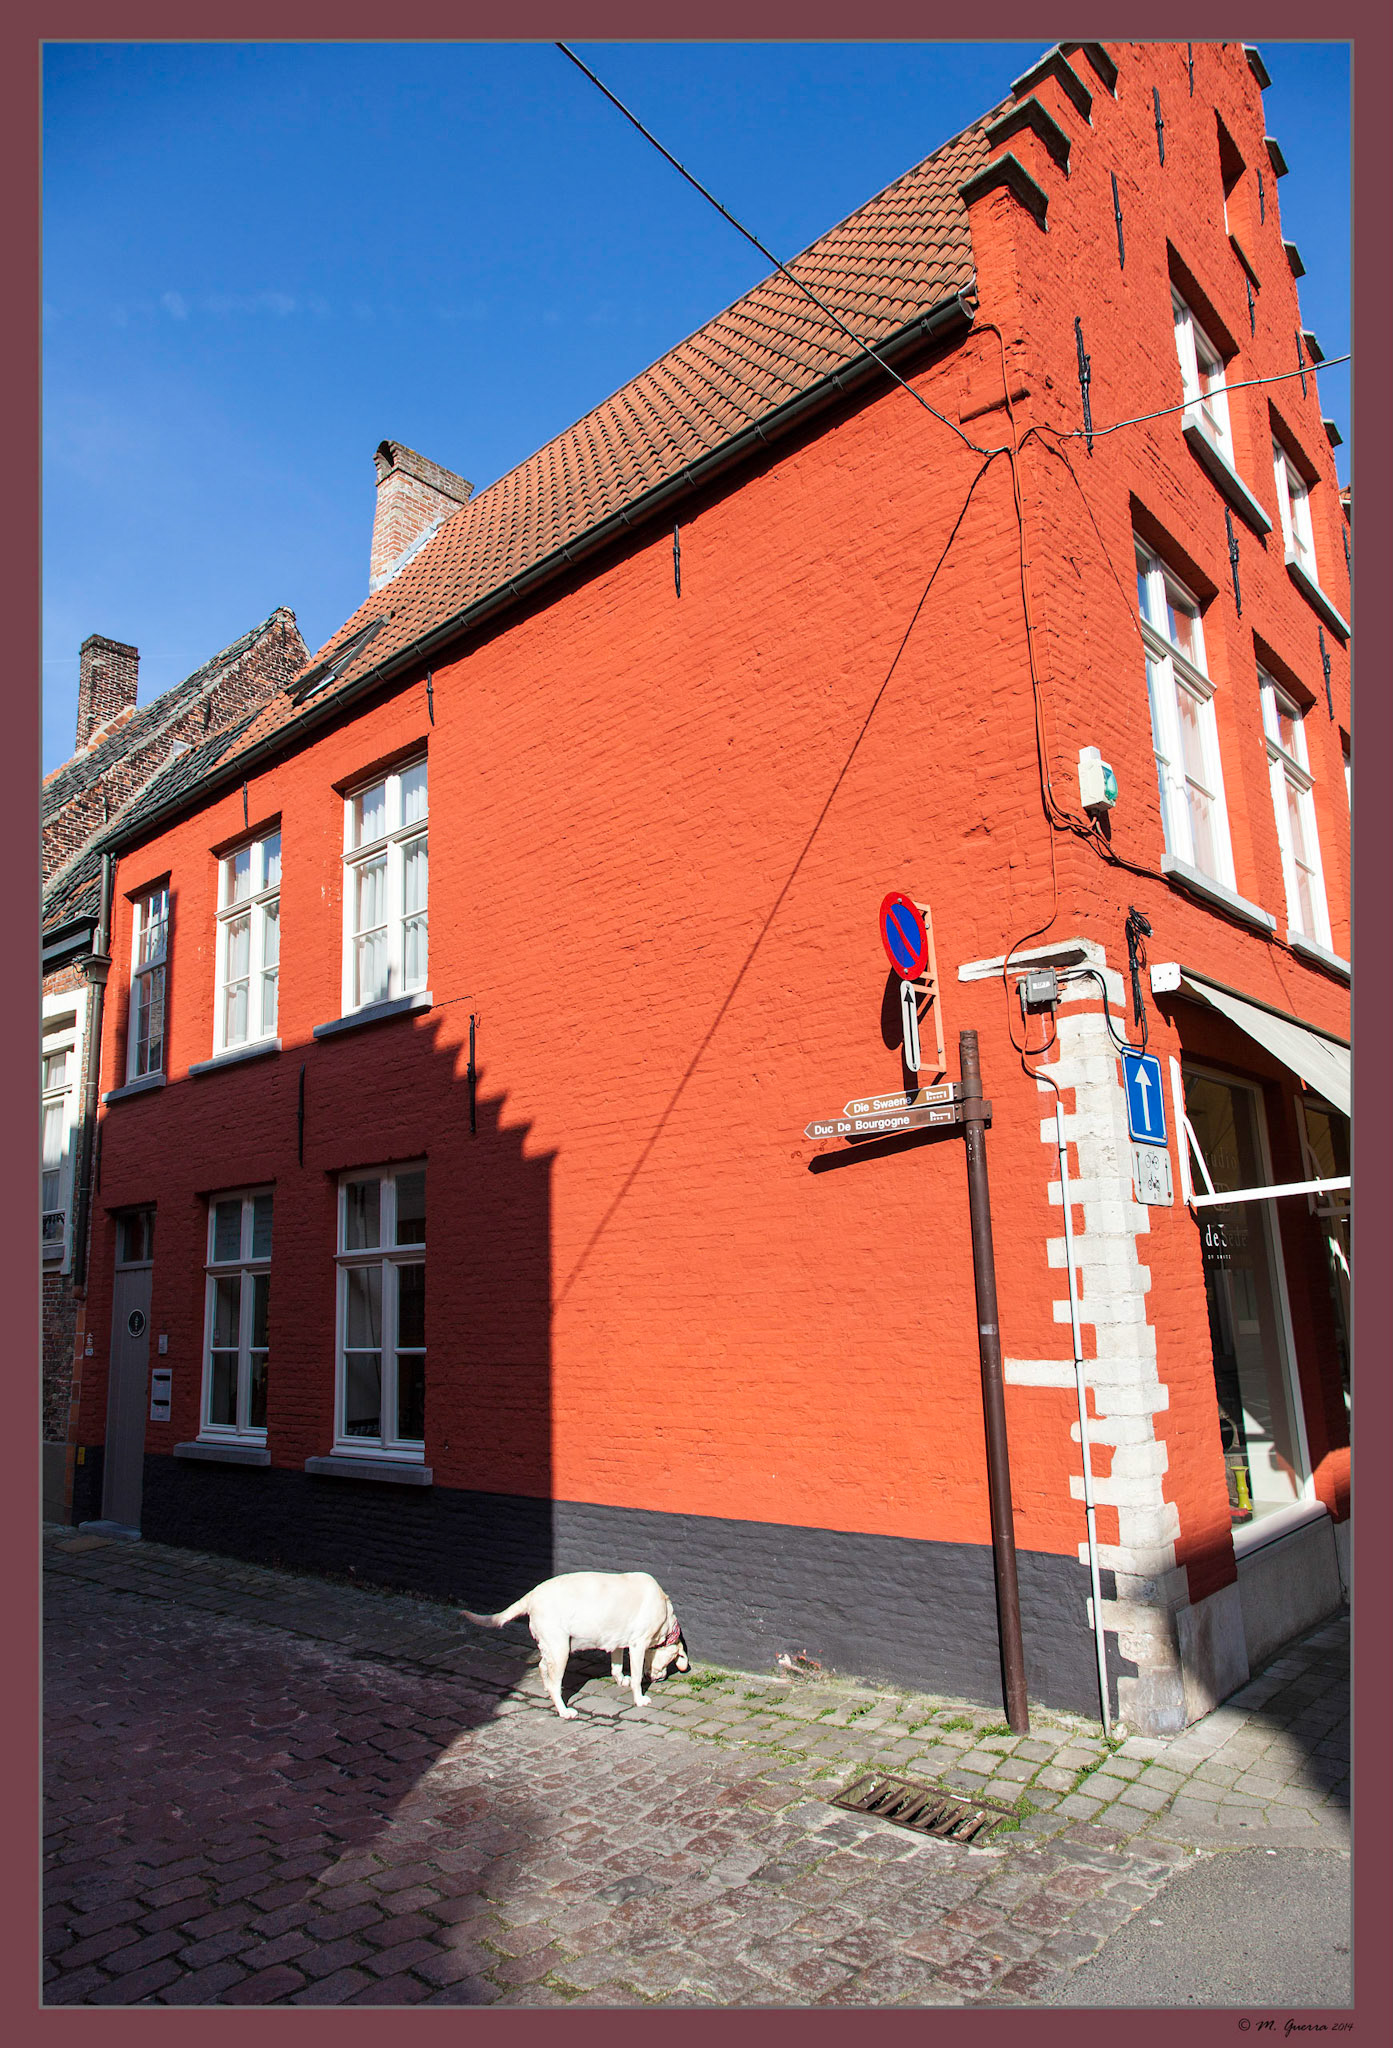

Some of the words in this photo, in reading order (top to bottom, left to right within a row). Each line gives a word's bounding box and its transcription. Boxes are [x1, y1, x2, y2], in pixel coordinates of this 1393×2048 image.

[853, 1103, 870, 1114] Die
[872, 1096, 913, 1111] Swaene
[814, 1125, 834, 1136] Duc
[837, 1122, 851, 1132] De
[855, 1116, 910, 1131] Bourgogne
